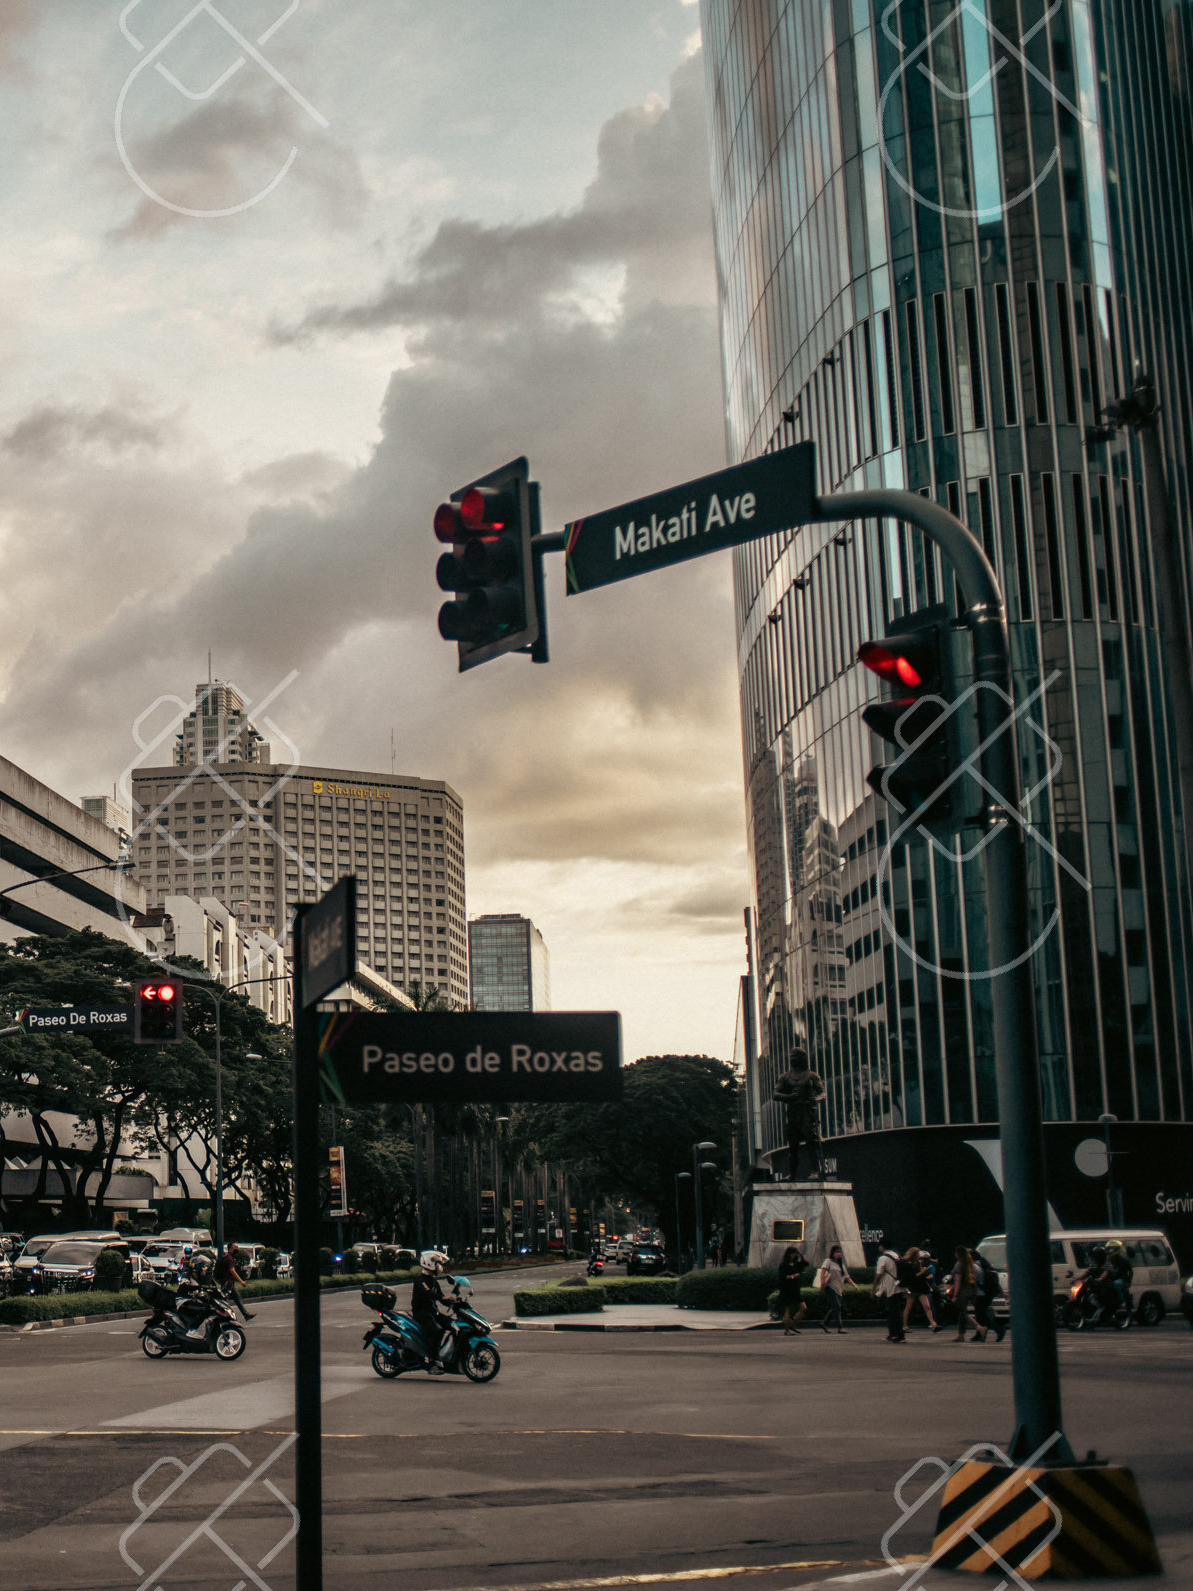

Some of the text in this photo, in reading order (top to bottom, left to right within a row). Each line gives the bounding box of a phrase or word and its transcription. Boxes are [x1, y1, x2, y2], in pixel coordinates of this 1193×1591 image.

[615, 492, 756, 561] Makati Ave
[29, 1011, 127, 1027] Paseo De Roxas
[362, 1044, 604, 1073] Paseo de Roxas
[1155, 1192, 1193, 1213] Servi
